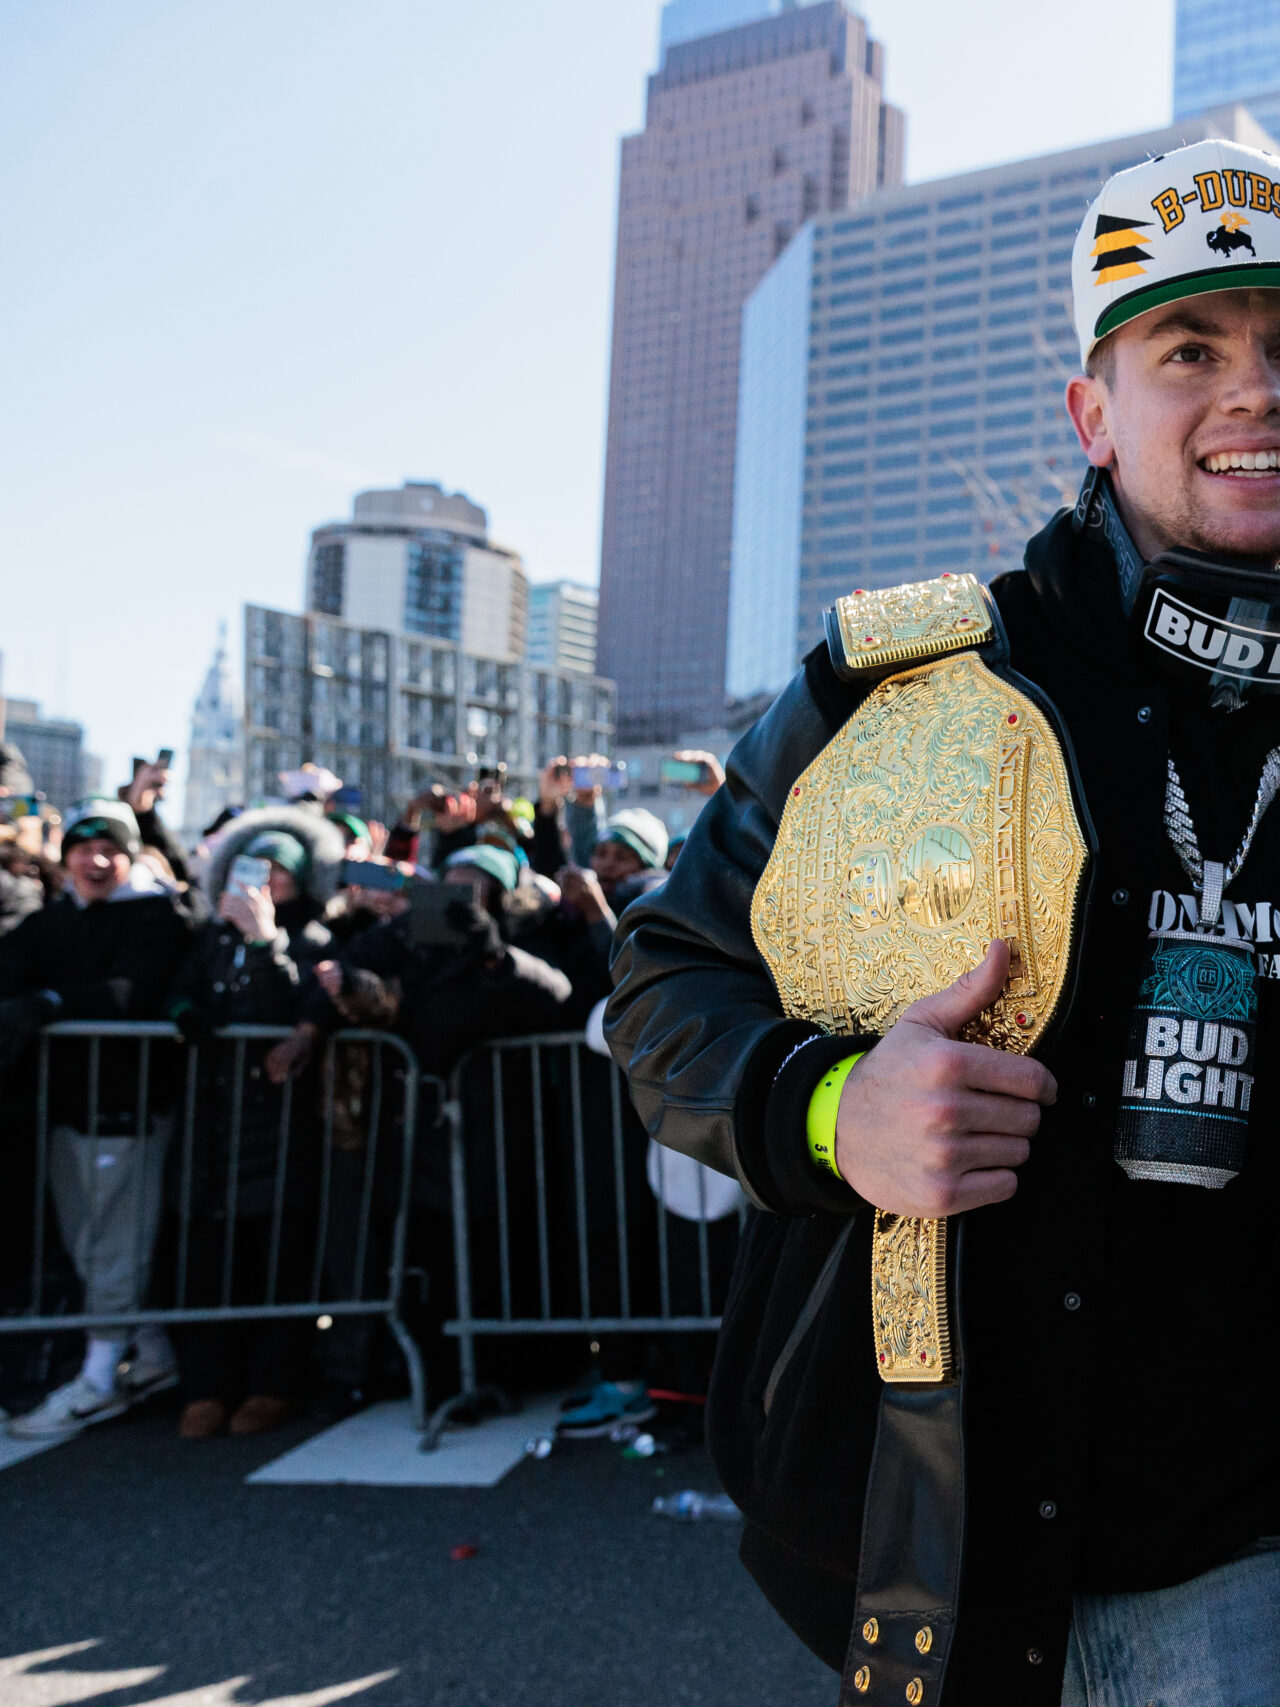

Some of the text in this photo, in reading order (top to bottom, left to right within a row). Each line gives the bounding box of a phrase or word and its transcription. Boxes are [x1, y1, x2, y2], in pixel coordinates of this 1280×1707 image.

[1154, 603, 1264, 669] BUD
[996, 744, 1019, 896] DEMON
[784, 856, 799, 961] WORLD
[1145, 1016, 1249, 1067] BUD
[1122, 1058, 1254, 1112] LIGHT
